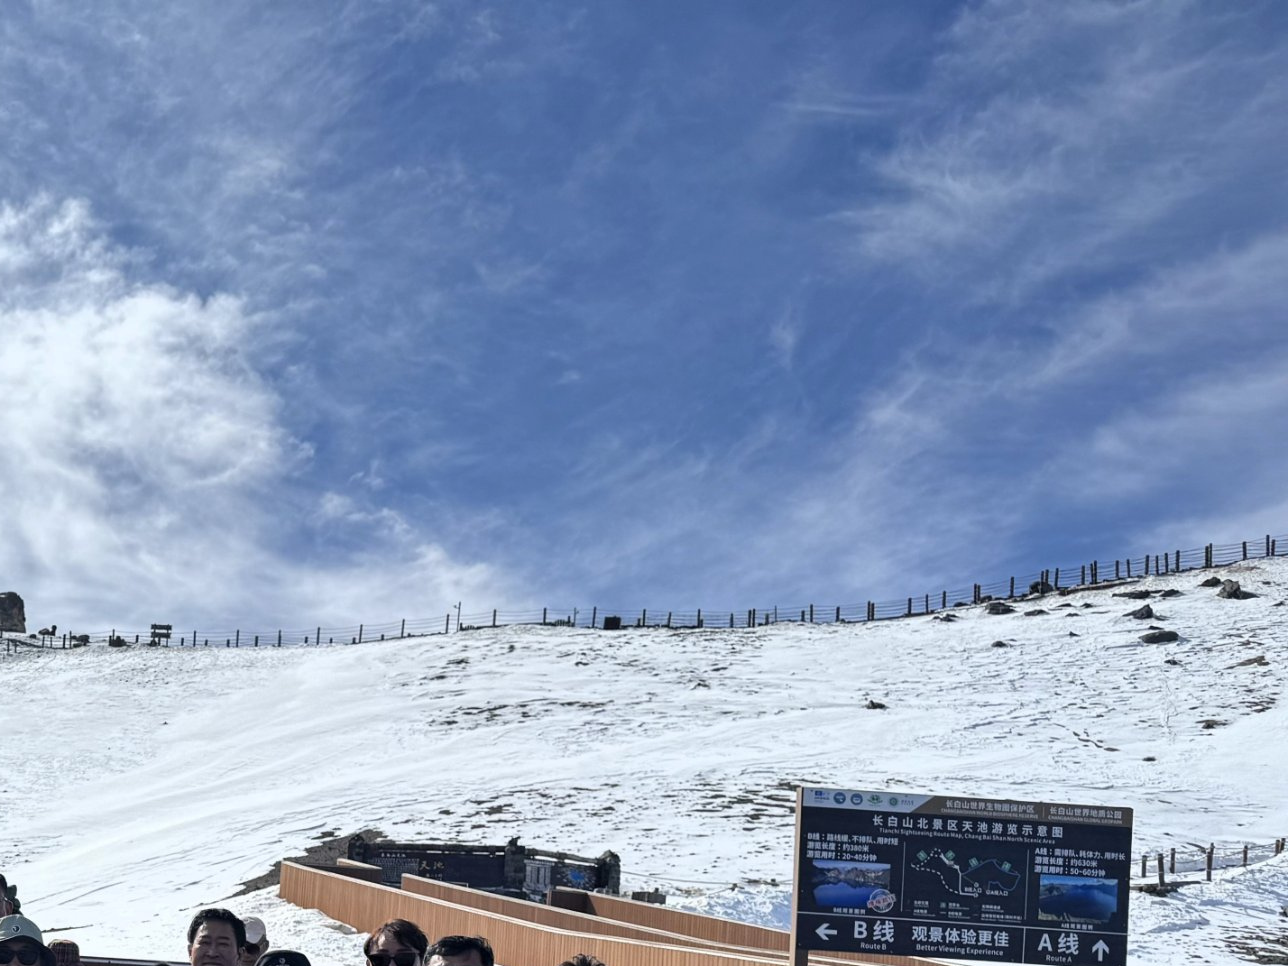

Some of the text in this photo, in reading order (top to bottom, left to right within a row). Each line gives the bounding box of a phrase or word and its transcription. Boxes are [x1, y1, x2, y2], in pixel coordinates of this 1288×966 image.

[872, 814, 1064, 838] 长白山北景区天池游览示意图
[911, 926, 1009, 947] 观景体验更佳
[860, 942, 881, 950] Route
[916, 943, 1004, 957] Better Viewing Experience
[1045, 954, 1066, 963] Route
